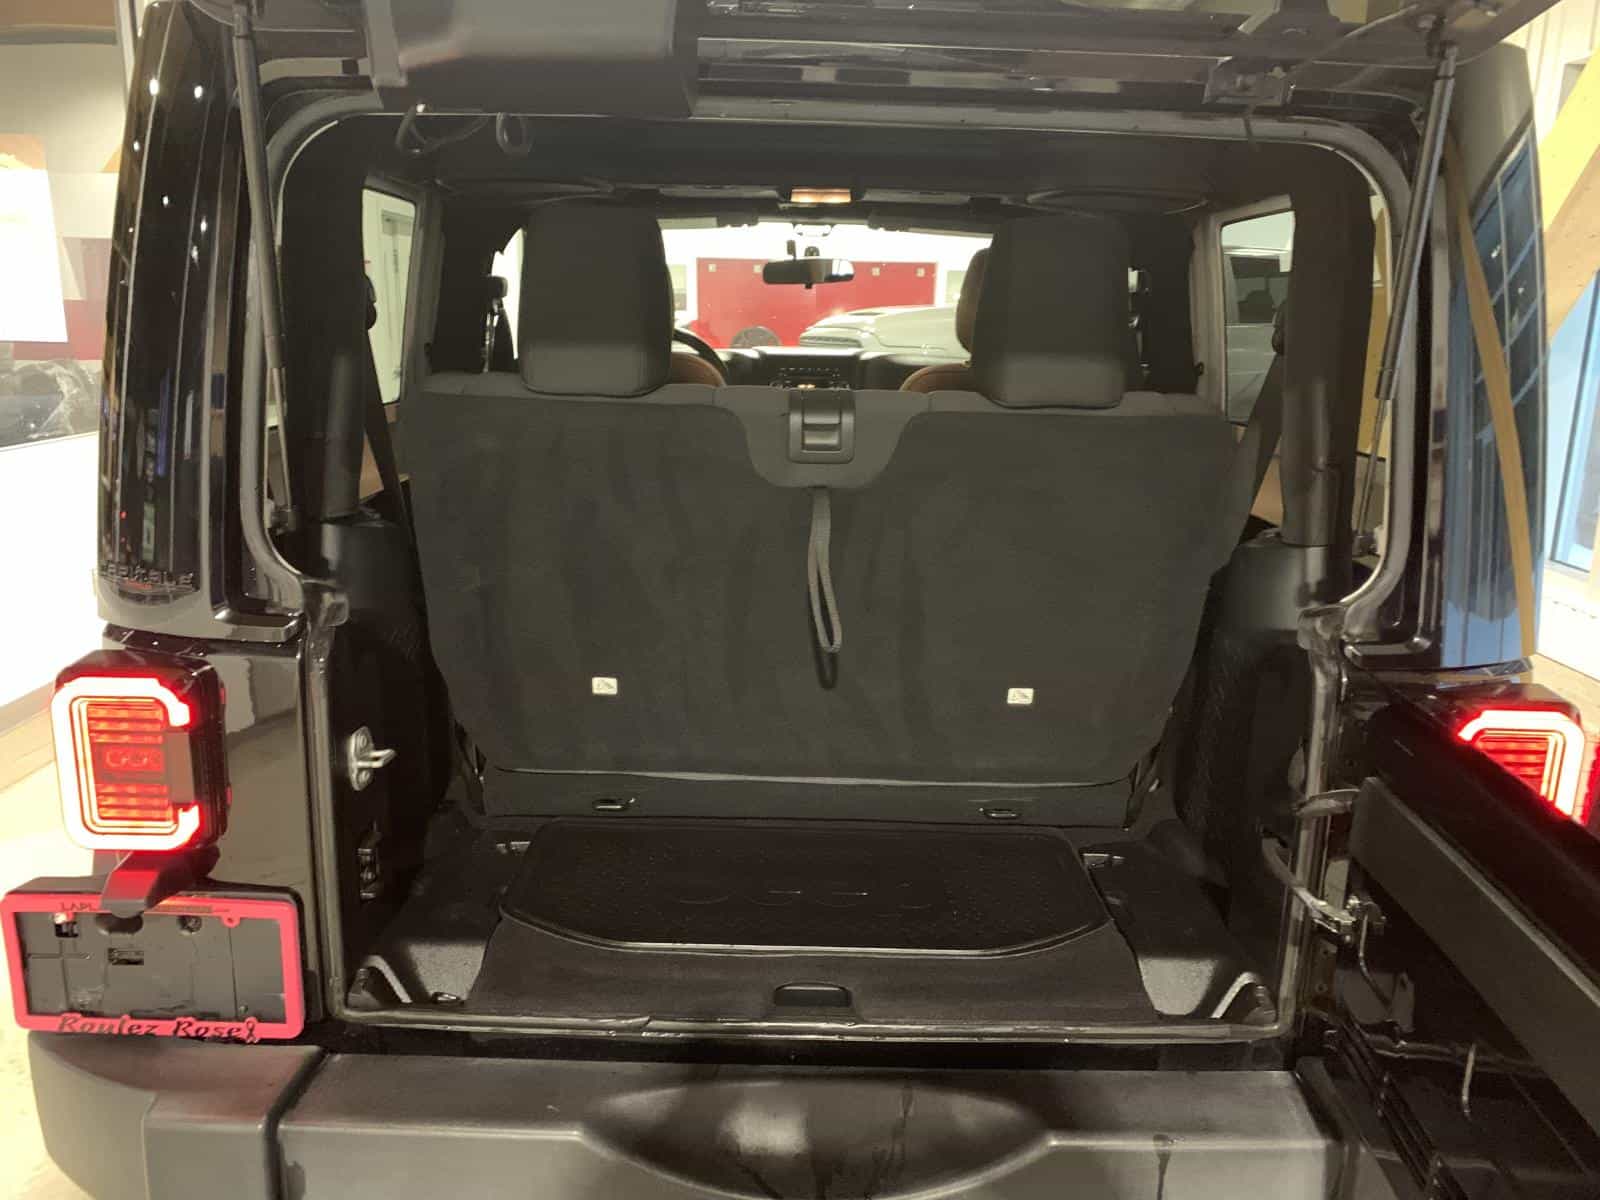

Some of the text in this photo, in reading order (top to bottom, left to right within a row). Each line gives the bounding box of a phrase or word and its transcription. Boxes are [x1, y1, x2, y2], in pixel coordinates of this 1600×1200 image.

[60, 902, 98, 911] LAPL
[58, 1014, 242, 1039] Roulez Rose
